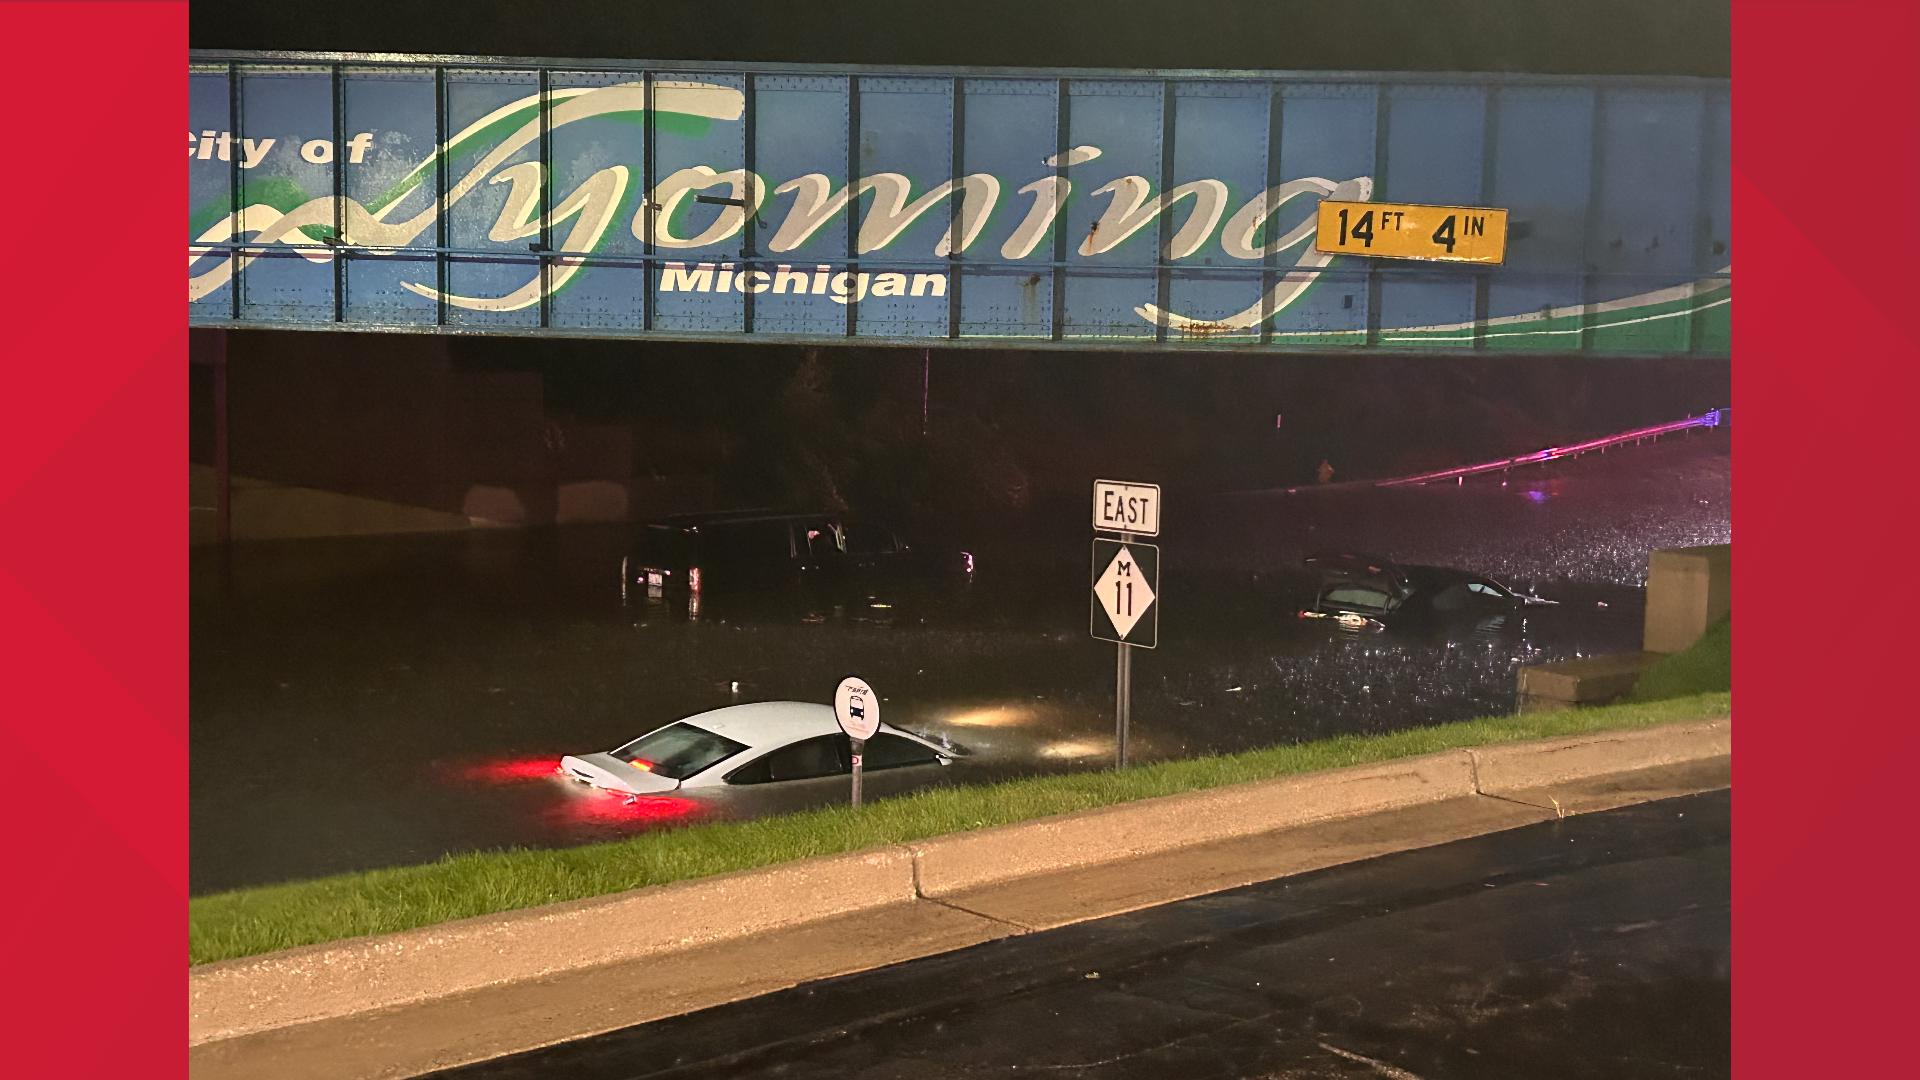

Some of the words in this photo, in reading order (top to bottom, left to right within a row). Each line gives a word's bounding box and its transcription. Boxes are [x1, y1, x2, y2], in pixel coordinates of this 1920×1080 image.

[301, 132, 373, 164] of
[1338, 208, 1375, 248] 14
[1381, 211, 1405, 231] FT
[1432, 215, 1456, 253] 4
[1463, 215, 1485, 237] IN
[659, 262, 947, 304] Michigan
[1103, 490, 1149, 525] EAST
[1117, 560, 1131, 577] M
[1115, 580, 1132, 617] 11
